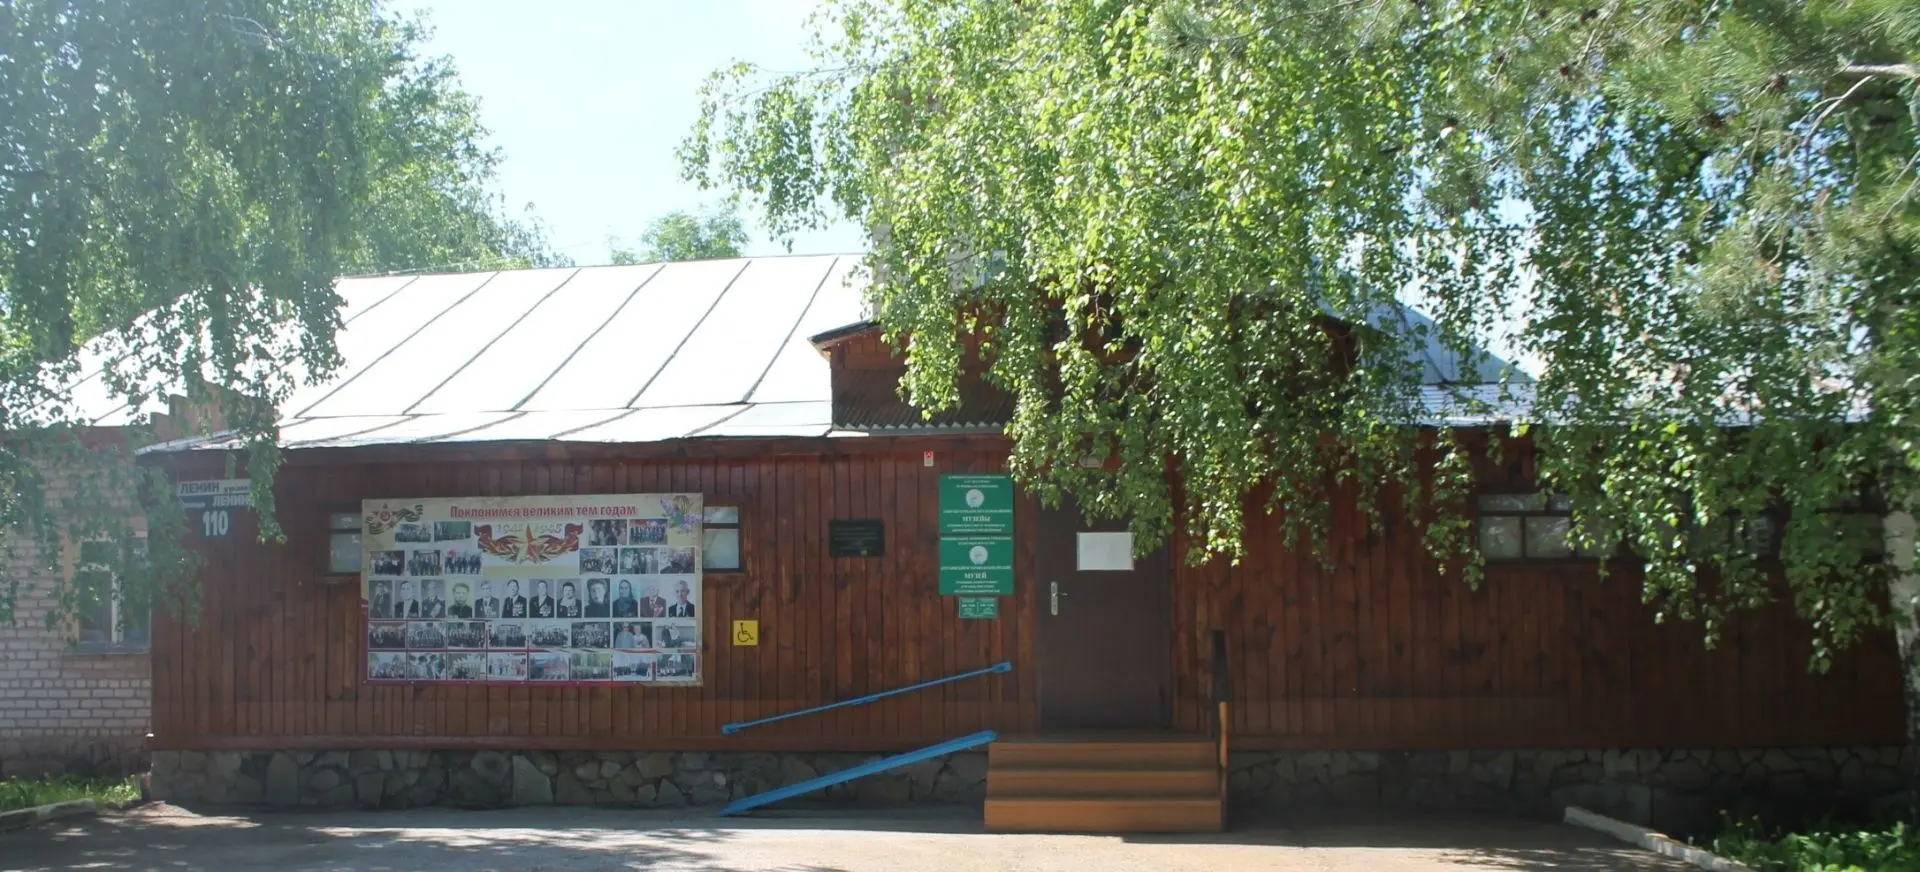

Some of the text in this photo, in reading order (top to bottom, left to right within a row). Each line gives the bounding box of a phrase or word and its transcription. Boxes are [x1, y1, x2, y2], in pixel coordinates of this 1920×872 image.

[180, 482, 220, 494] ЛЕНИН
[450, 504, 637, 518] Поклонимся великим тем годам
[202, 510, 229, 536] 110
